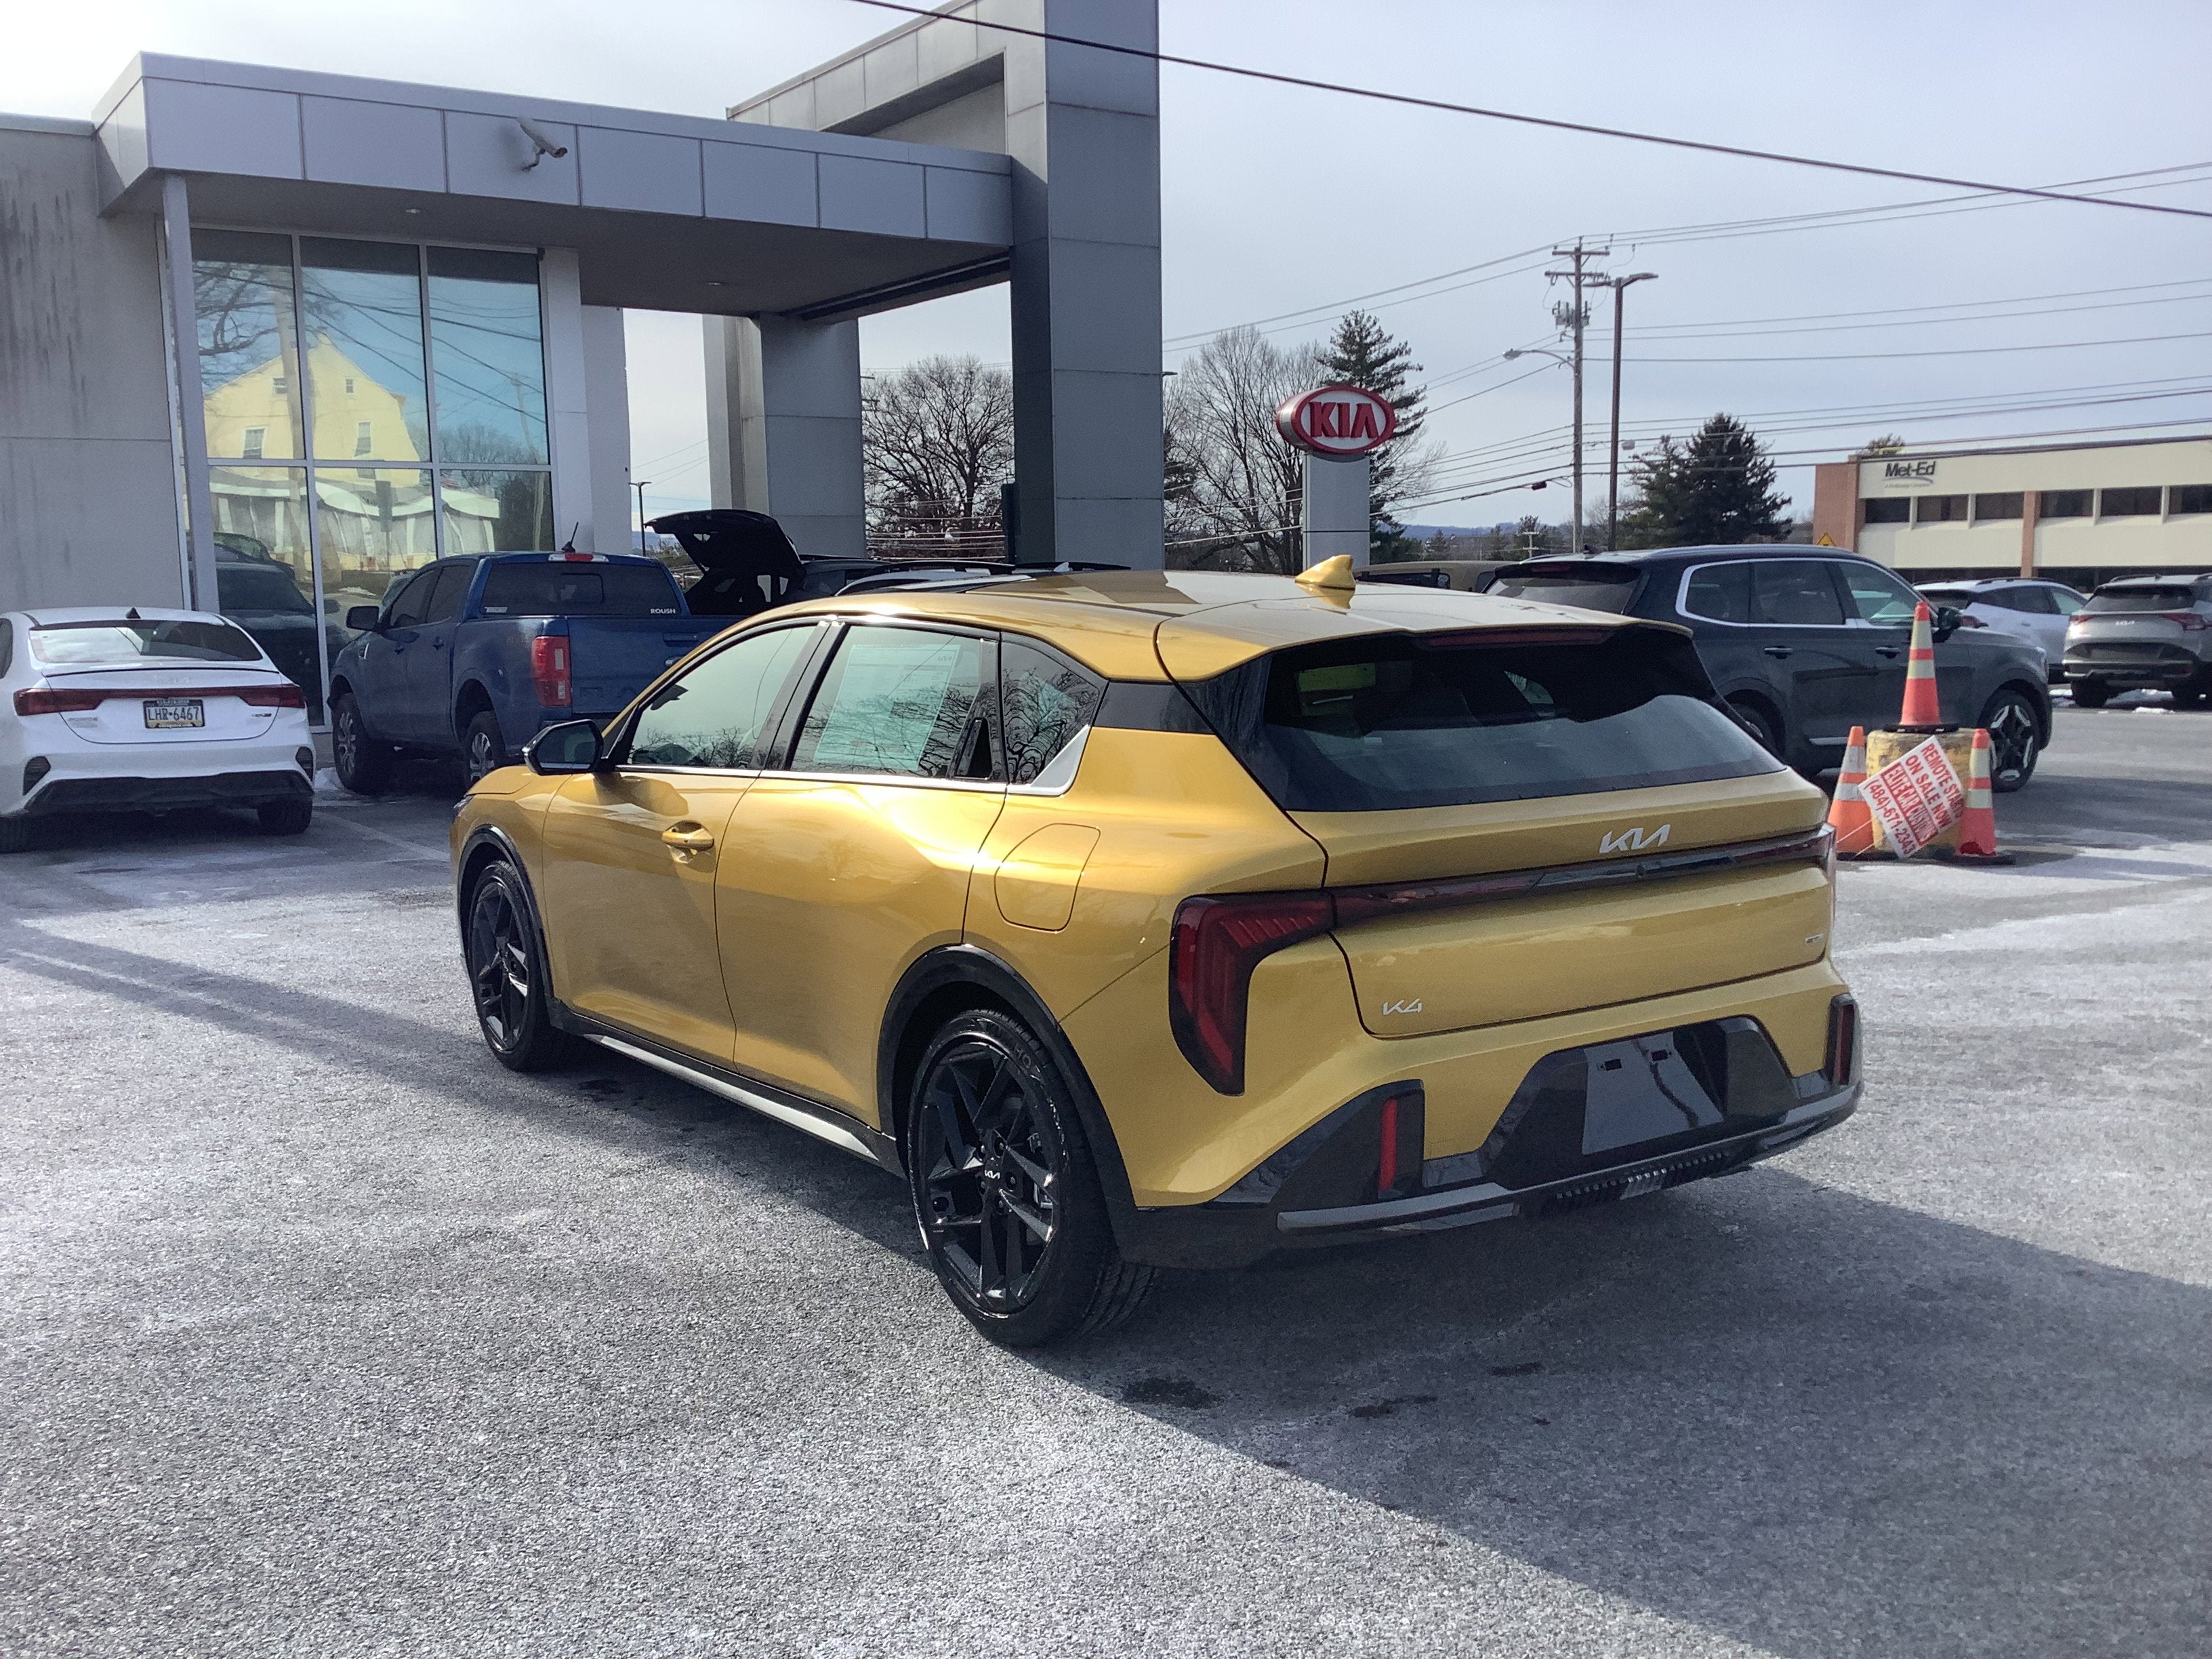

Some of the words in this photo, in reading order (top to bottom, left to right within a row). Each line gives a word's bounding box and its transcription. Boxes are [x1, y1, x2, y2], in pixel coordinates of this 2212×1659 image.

[1309, 402, 1379, 438] KIA
[1885, 461, 1936, 477] Met-Ed
[1921, 743, 1953, 787] REMOTE
[1884, 766, 1911, 796] ELITE
[1906, 755, 1923, 775] ON
[1916, 773, 1940, 804] SALE
[1931, 802, 1952, 828] NOW
[1896, 787, 1920, 812] CAR
[1599, 824, 1671, 853] KIA
[1382, 998, 1422, 1015] K4
